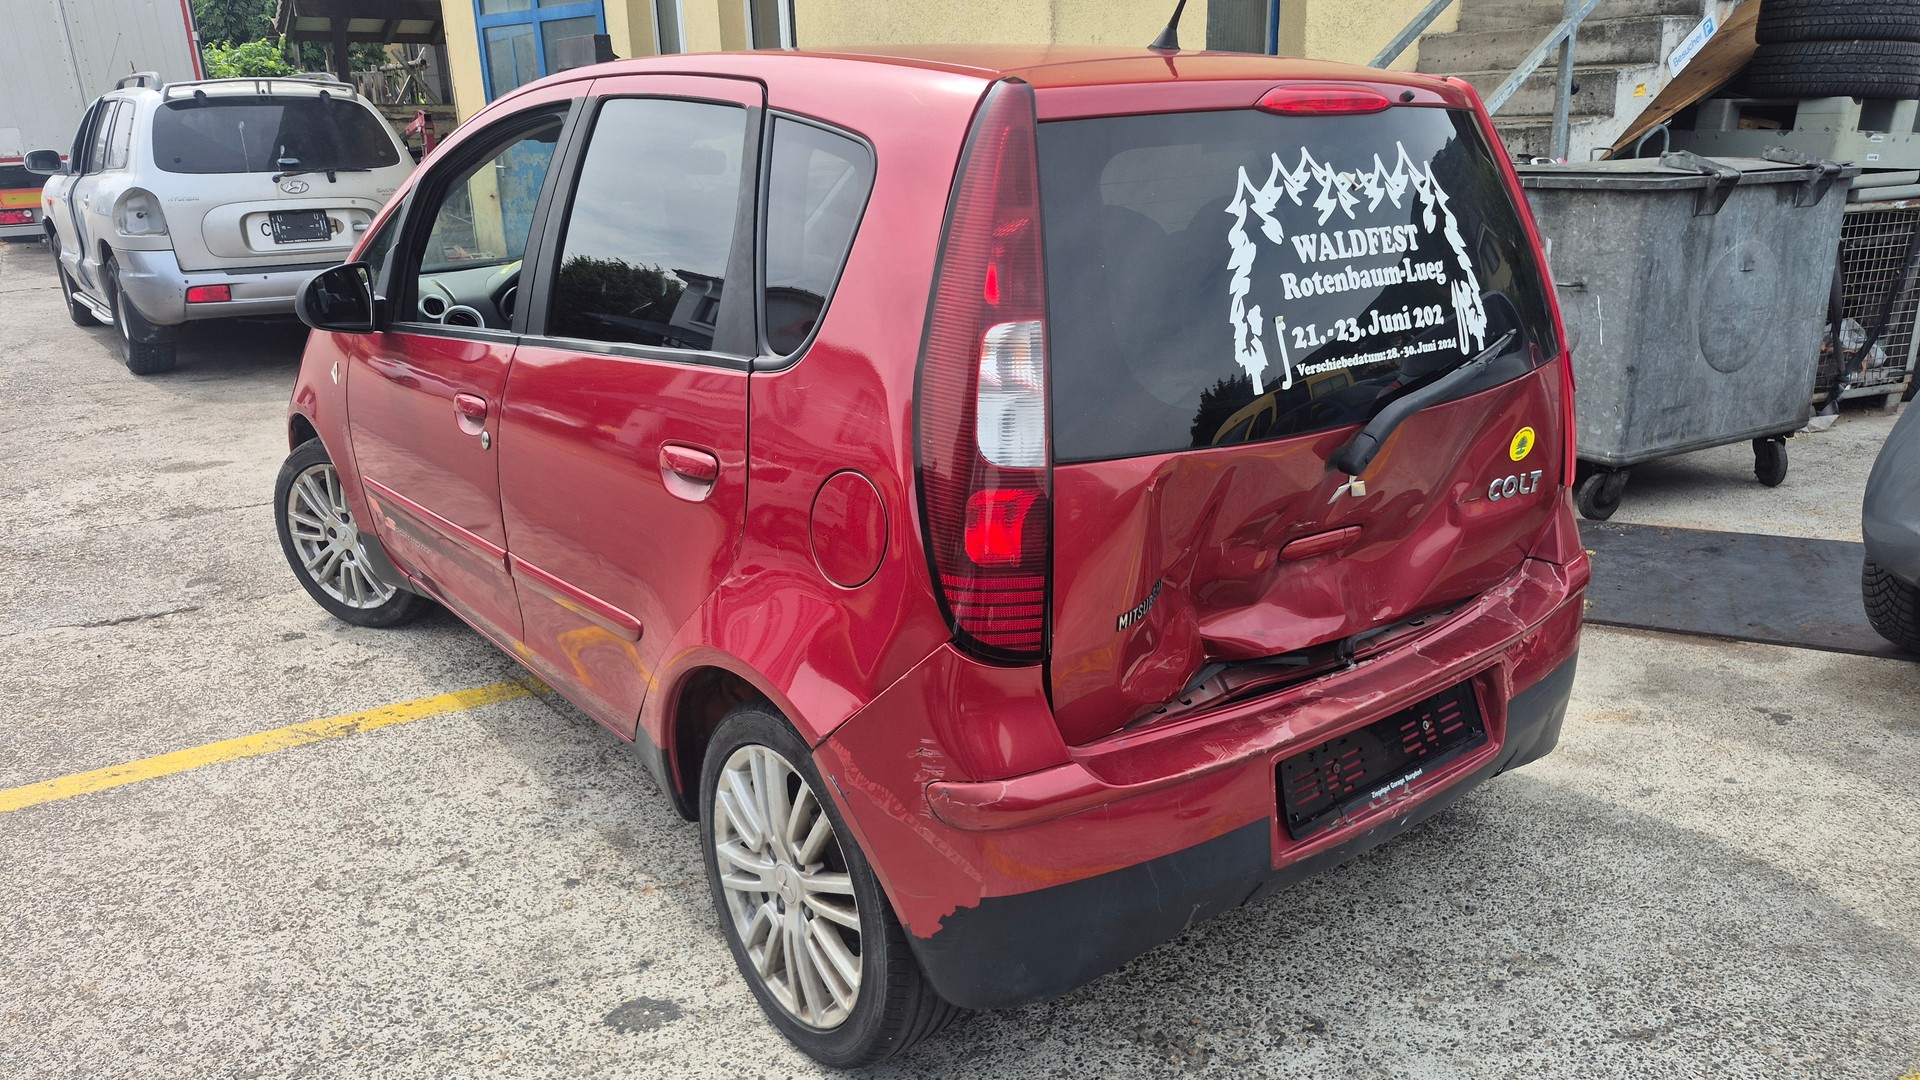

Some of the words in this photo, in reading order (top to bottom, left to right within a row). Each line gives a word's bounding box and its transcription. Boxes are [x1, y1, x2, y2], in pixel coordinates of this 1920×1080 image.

[1673, 32, 1702, 67] Besucher
[1291, 224, 1419, 264] WALDFEST
[1280, 257, 1447, 300] Rotenbaum-Lueg
[1368, 305, 1412, 336] Juni
[1412, 304, 1445, 329] 202
[1295, 350, 1386, 377] Verschiebedatum:
[1416, 339, 1437, 354] Juni
[1437, 337, 1458, 350] 2024
[1488, 469, 1542, 502] COLT
[1390, 778, 1405, 789] Garage
